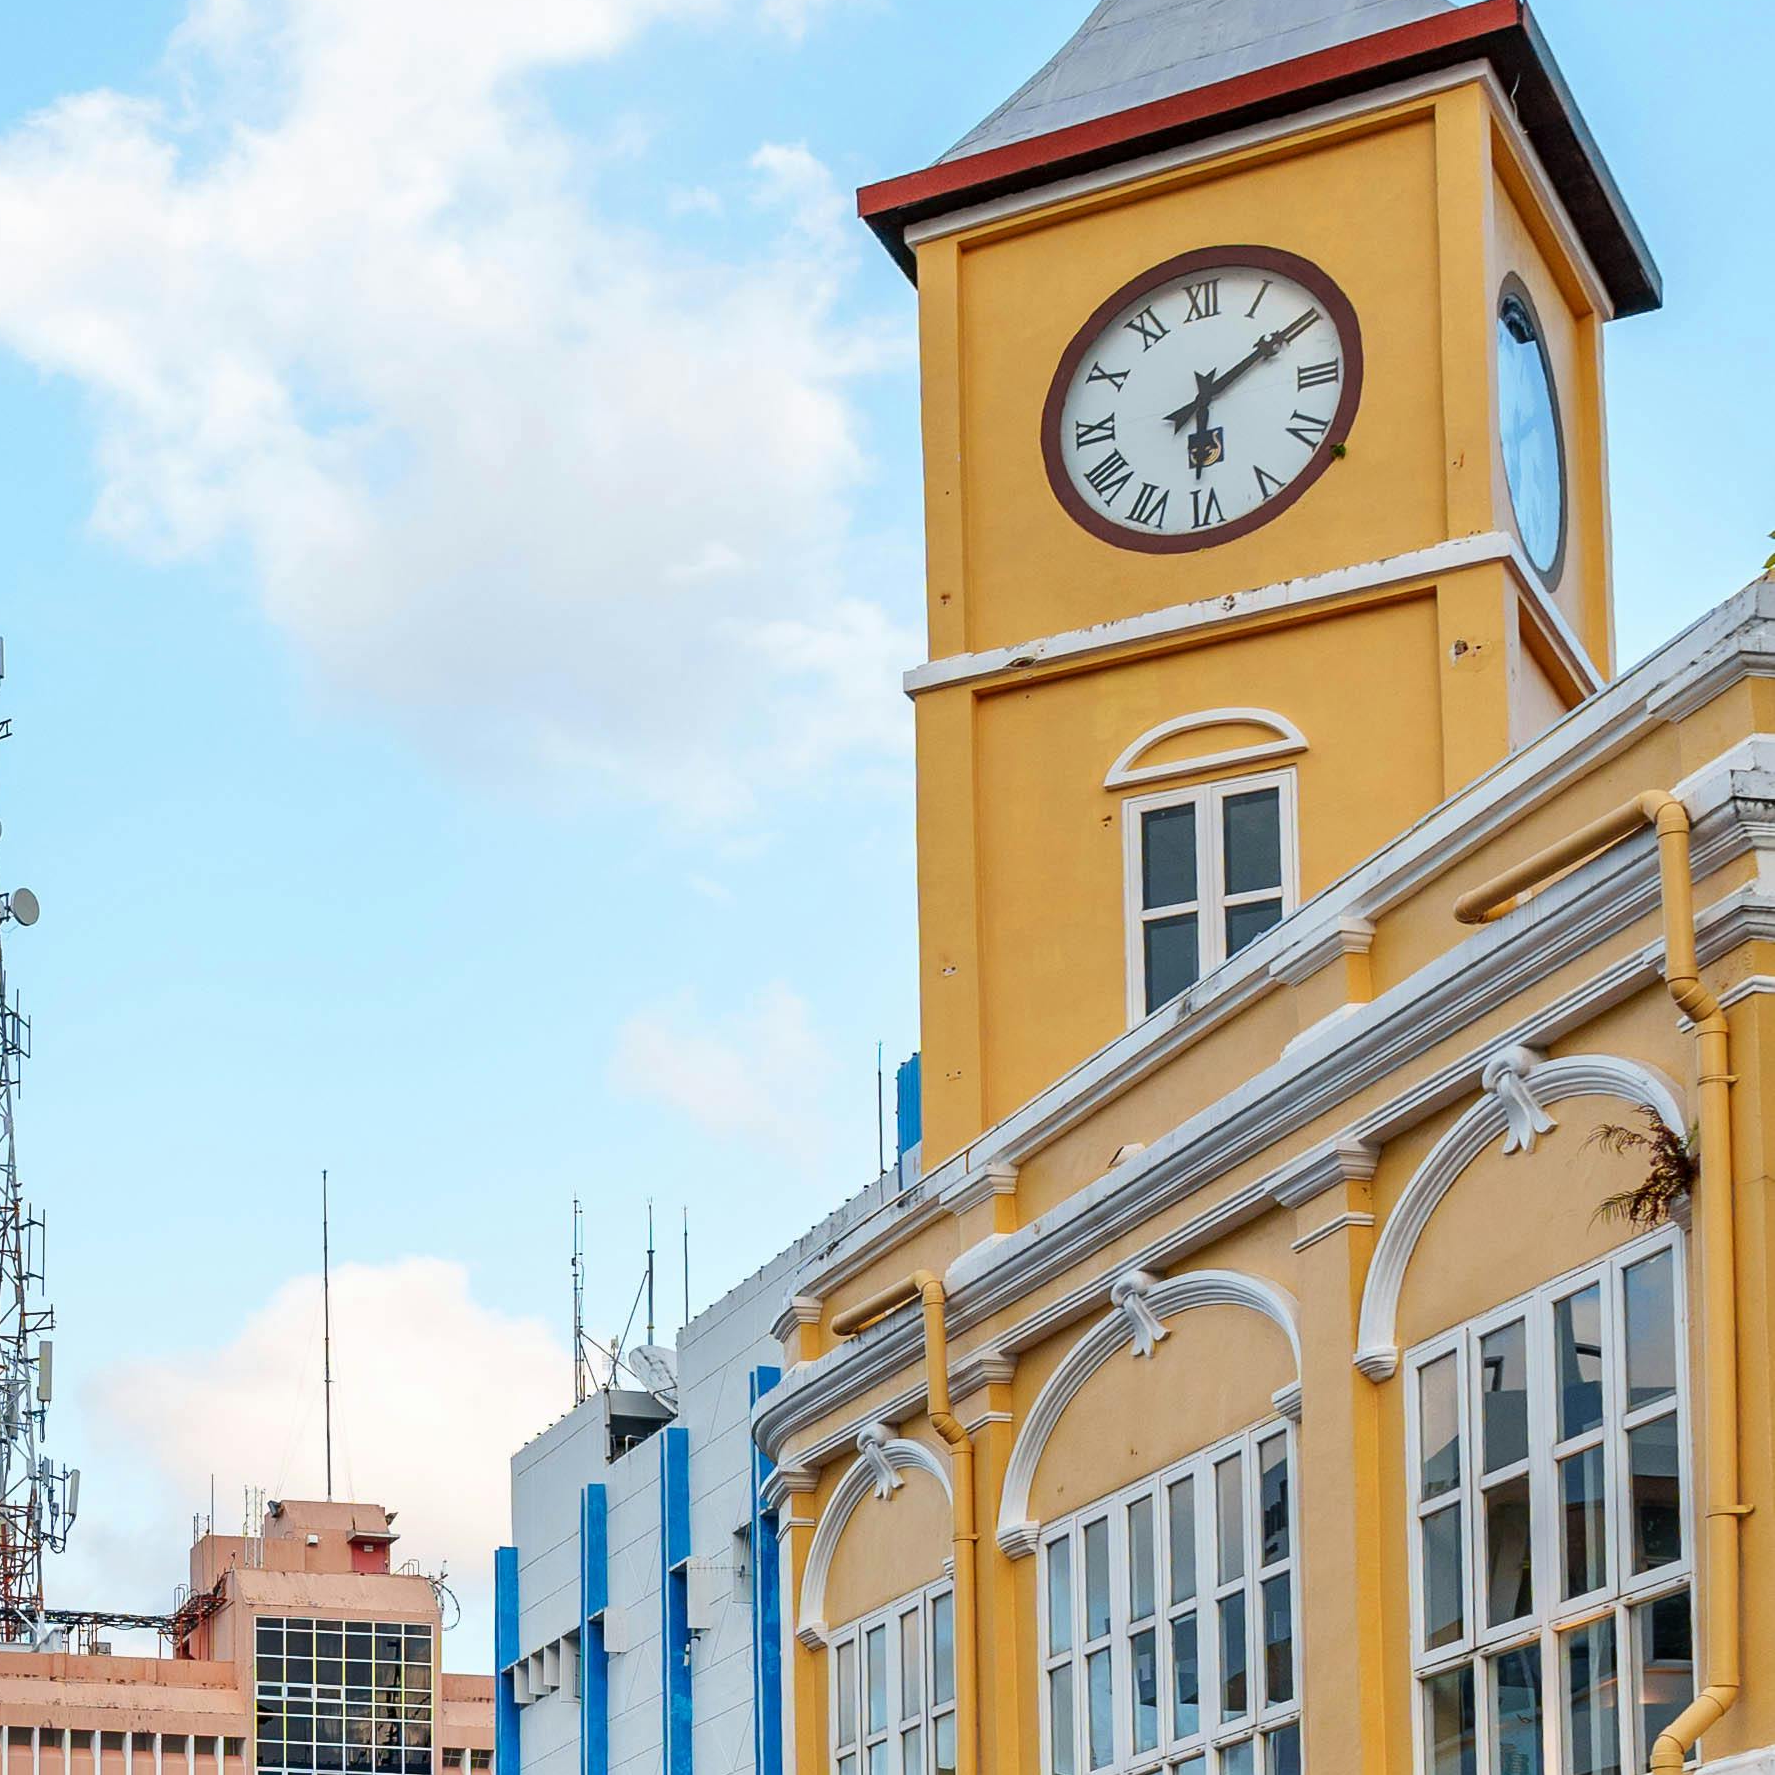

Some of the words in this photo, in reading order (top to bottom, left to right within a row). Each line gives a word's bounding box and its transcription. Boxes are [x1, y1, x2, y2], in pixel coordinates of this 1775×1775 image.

[1182, 278, 1222, 324] XII
[1244, 279, 1273, 319] I
[1124, 305, 1172, 352] XI
[1086, 361, 1130, 392] X
[1297, 357, 1339, 392] III
[1075, 412, 1116, 449] IX
[1285, 409, 1331, 453] IV
[1083, 448, 1136, 507] VIII
[1253, 465, 1286, 502] V
[1125, 482, 1171, 529] VII
[1190, 487, 1226, 529] VI
